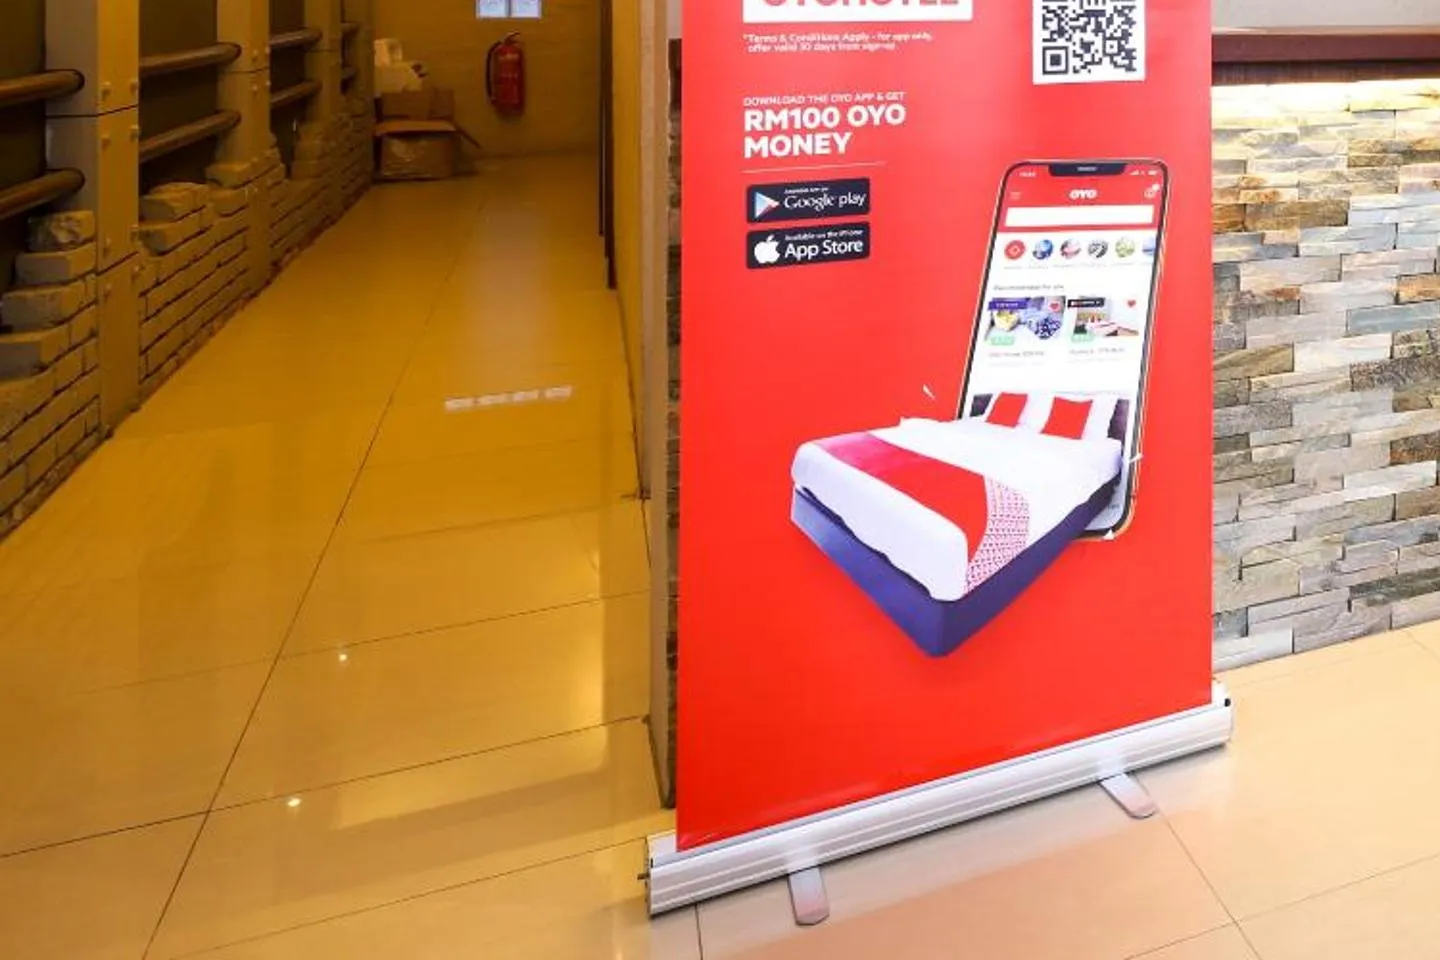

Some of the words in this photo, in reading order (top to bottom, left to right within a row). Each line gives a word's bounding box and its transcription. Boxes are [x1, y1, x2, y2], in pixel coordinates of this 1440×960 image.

[743, 95, 805, 107] DOWNLOAD
[854, 92, 875, 102] APP
[885, 90, 906, 101] GET
[744, 106, 840, 132] RM100
[847, 103, 906, 127] OYO
[744, 132, 852, 158] MONEY
[783, 192, 834, 211] Google
[838, 191, 866, 208] play
[784, 243, 819, 260] App
[822, 240, 864, 255] Store
